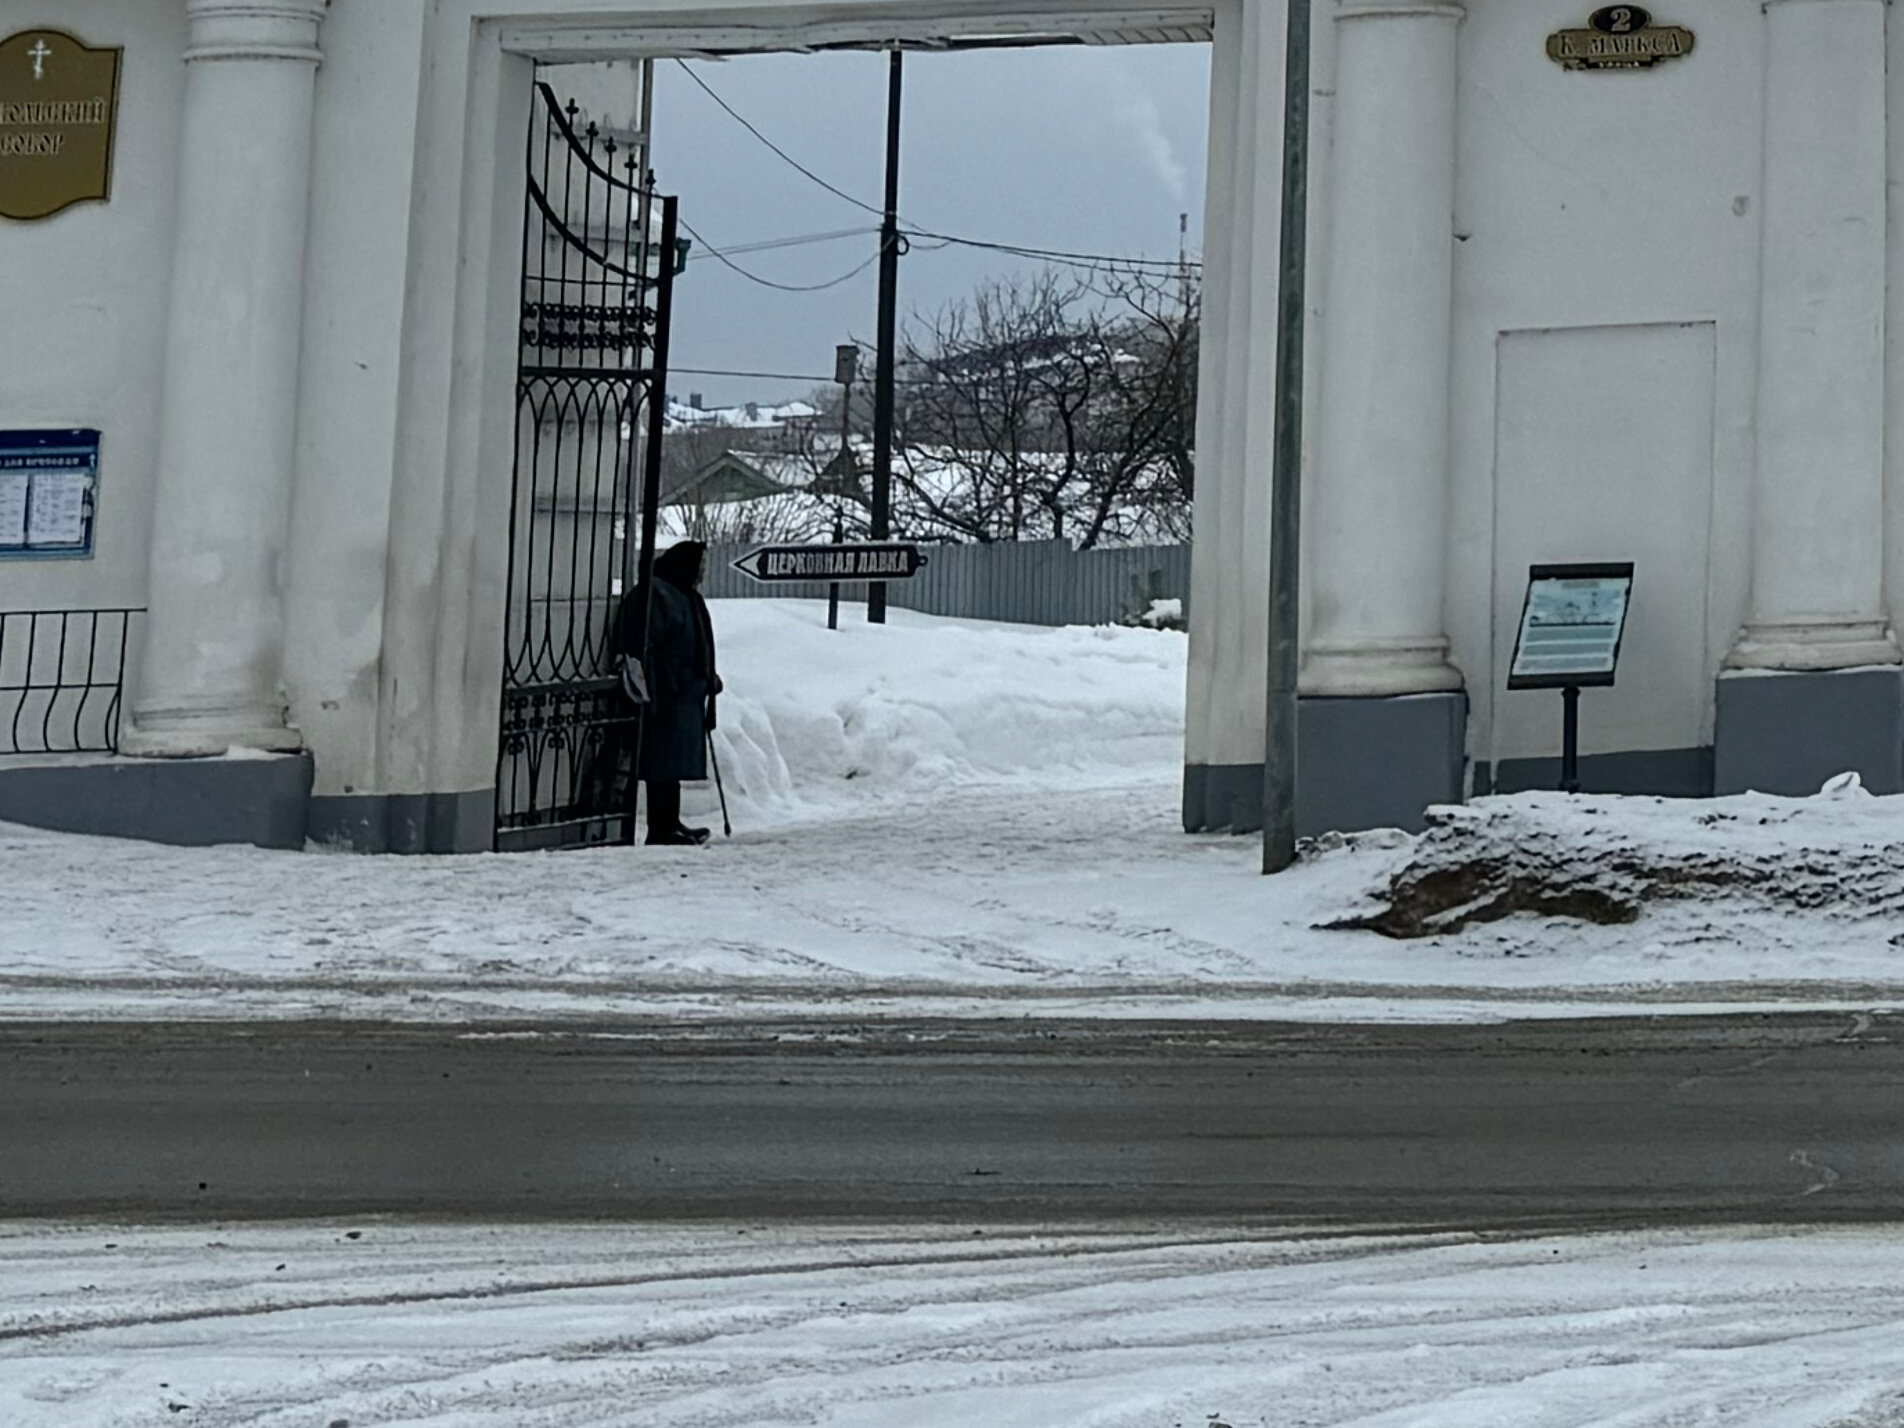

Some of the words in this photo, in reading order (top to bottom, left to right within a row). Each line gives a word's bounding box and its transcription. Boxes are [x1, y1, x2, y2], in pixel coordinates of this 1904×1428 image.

[1610, 8, 1631, 32] 2
[1588, 32, 1682, 55] МАРКСА
[767, 552, 855, 575] ЦЕРКОВНАЯ
[857, 551, 908, 574] ЛАВКА
